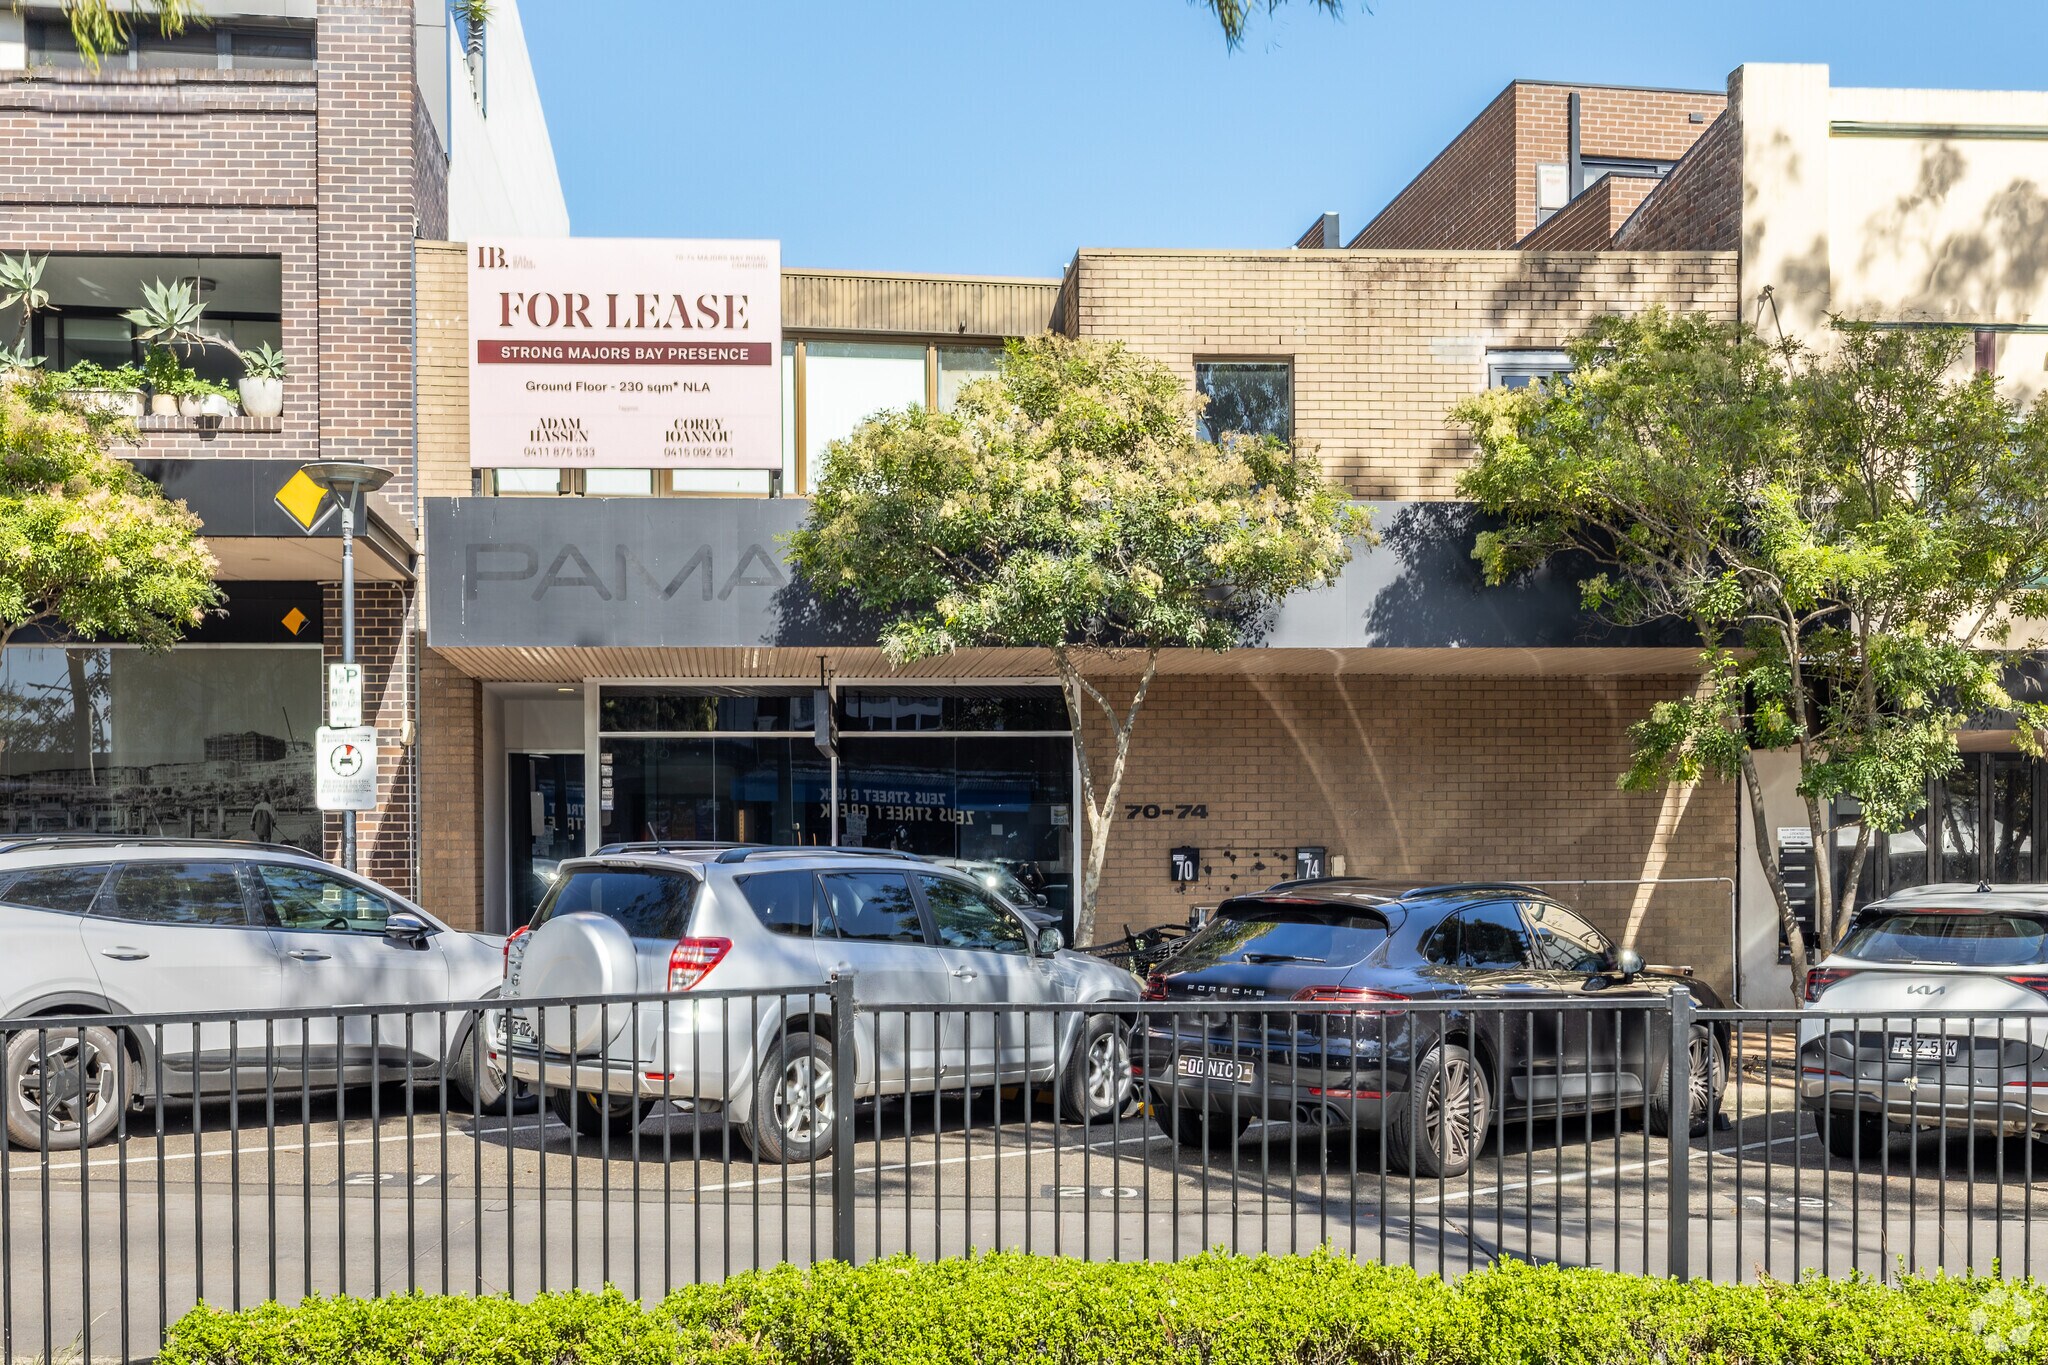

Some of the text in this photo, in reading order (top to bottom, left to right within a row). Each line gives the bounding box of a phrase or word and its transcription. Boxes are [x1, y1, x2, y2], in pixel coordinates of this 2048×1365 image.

[499, 292, 749, 329] FOR LEASE
[501, 346, 749, 361] STRONG MAJORS BAY PRESENCE
[525, 380, 572, 393] Ground
[576, 381, 607, 393] Floor
[619, 381, 643, 393] 230
[683, 382, 711, 393] NLA
[537, 417, 581, 430] ADAM
[673, 417, 724, 430] COREY
[530, 430, 589, 443] HASSEN
[665, 430, 733, 443] IOANNOU
[523, 447, 550, 458] 0411
[692, 447, 712, 458] 092
[716, 447, 734, 458] 921
[1125, 804, 1209, 820] 70-74
[1176, 860, 1193, 881] 70
[1304, 859, 1320, 879] 74
[1187, 984, 1265, 997] PORSCHE
